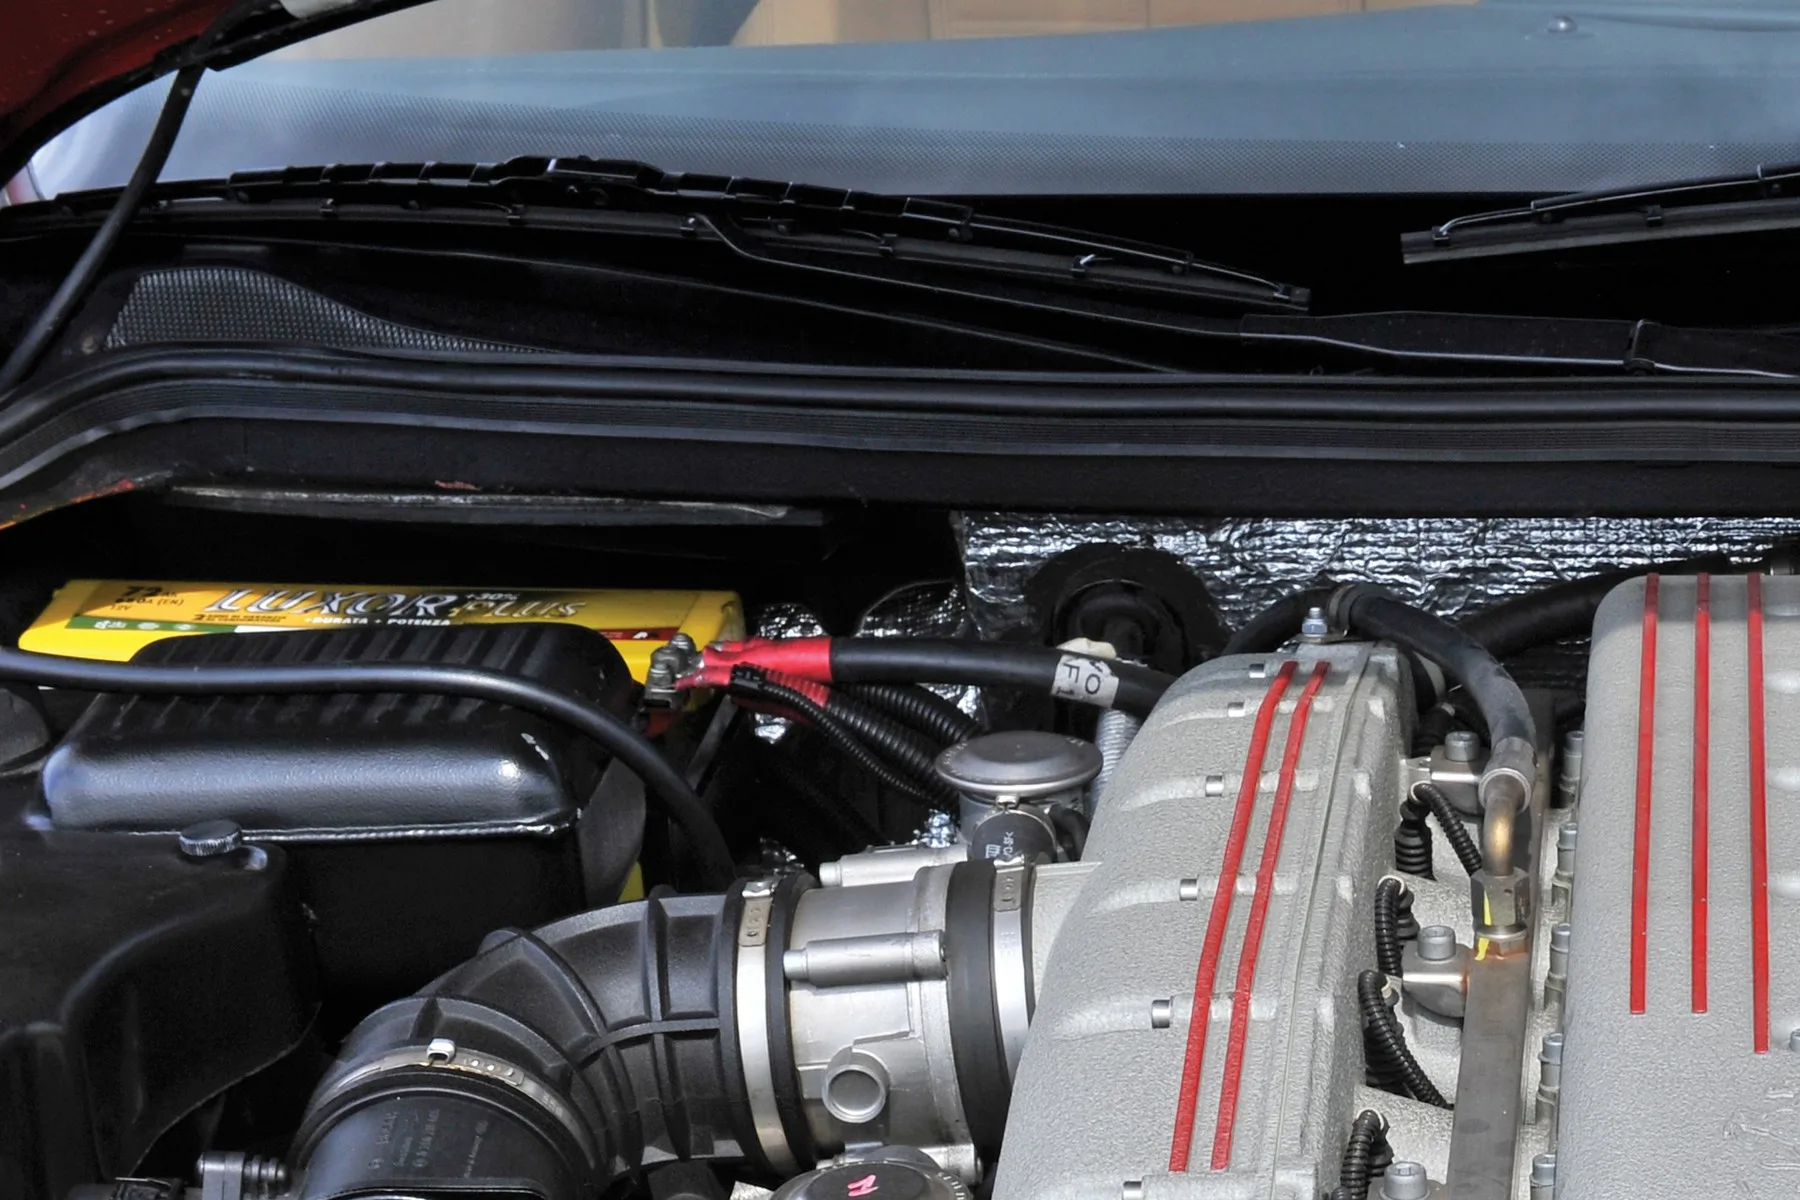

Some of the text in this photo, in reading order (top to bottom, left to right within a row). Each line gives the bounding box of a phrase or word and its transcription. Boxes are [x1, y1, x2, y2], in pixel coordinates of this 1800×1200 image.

[203, 588, 586, 618] LUXOR PLUS
[386, 617, 451, 626] POTENZA
